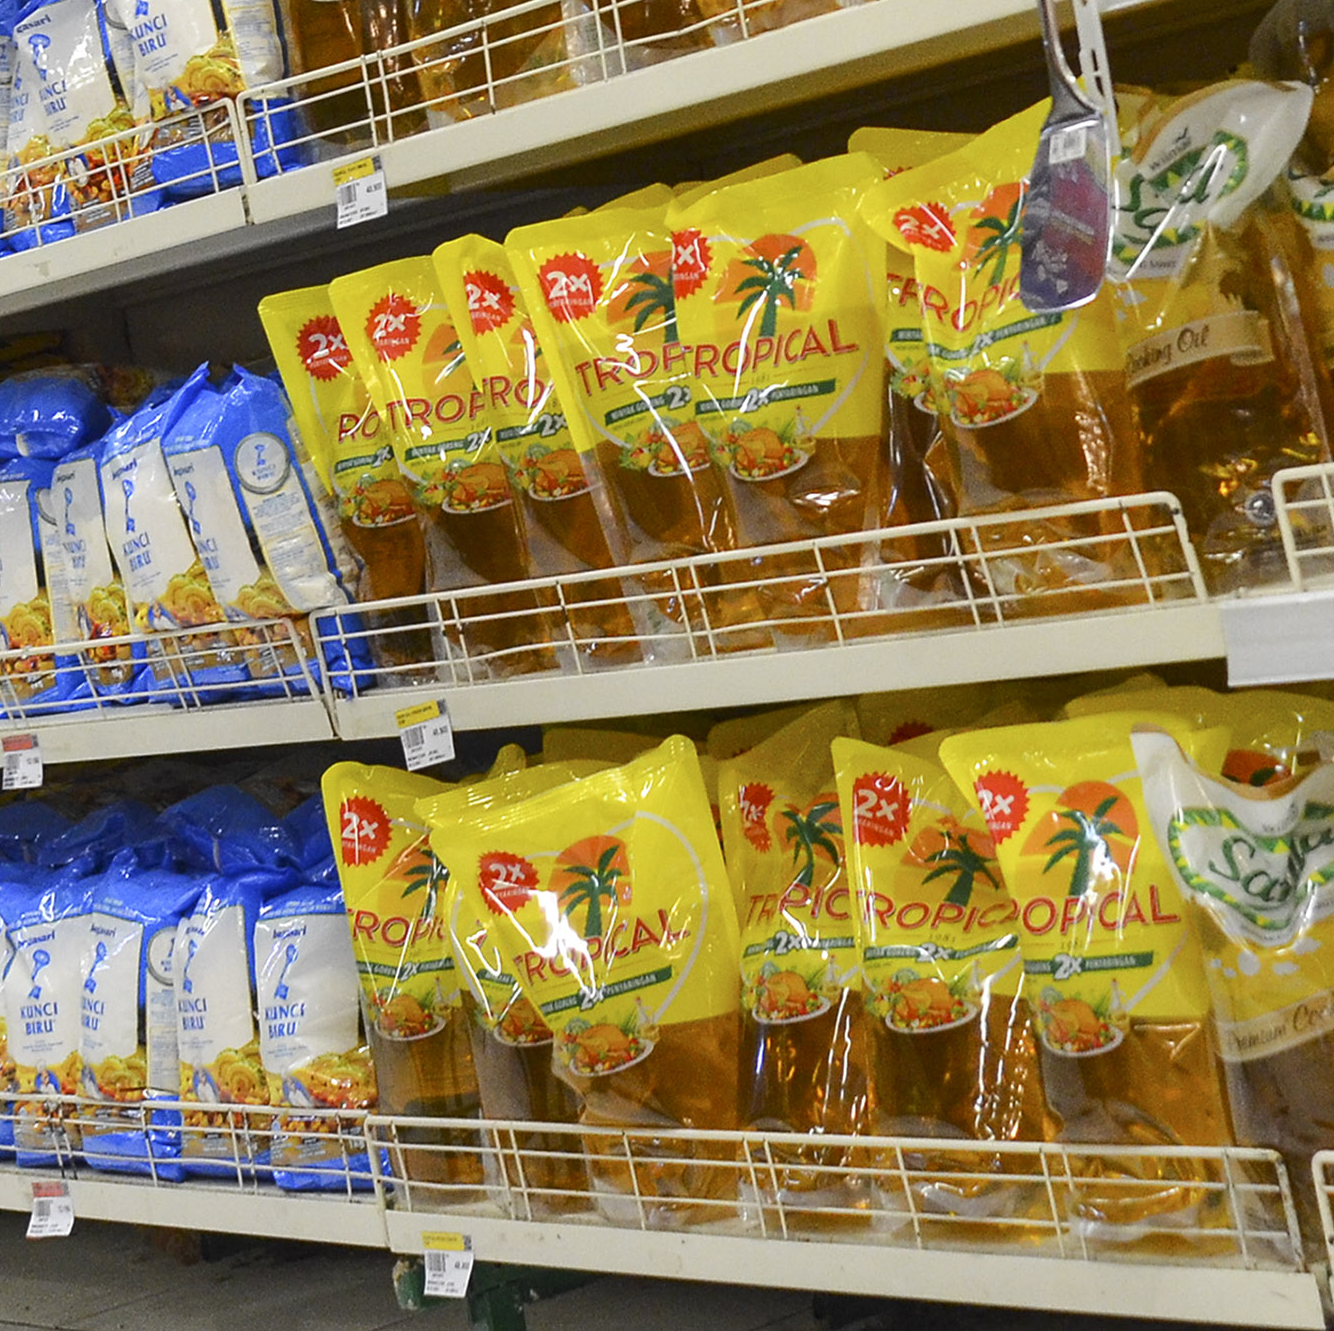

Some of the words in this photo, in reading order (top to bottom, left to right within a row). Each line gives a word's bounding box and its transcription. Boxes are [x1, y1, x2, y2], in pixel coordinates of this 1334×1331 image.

[130, 14, 167, 41] KUNCI
[138, 34, 167, 57] BIRU
[464, 282, 502, 311] 2x
[545, 270, 590, 300] 2x
[372, 312, 406, 340] 2x
[1176, 322, 1210, 351] Oil
[308, 332, 347, 359] 2x
[684, 319, 859, 379] TROPICAL
[538, 414, 568, 437] 2x
[465, 427, 492, 453] 2x
[122, 531, 151, 557] KUNCI
[855, 789, 900, 821] 2x
[342, 812, 379, 839] 2x
[489, 862, 526, 892] 2x
[1022, 884, 1181, 937] OPICAL
[774, 931, 802, 955] 2x
[402, 963, 420, 982] 2x
[1053, 952, 1083, 982] 2x
[606, 973, 658, 997] PENYARINGAN
[19, 1002, 59, 1021] KUNCI
[178, 997, 208, 1015] KUNCI
[25, 1018, 55, 1036] BIRU
[181, 1015, 206, 1032] BIRU
[267, 1019, 298, 1039] BIRU
